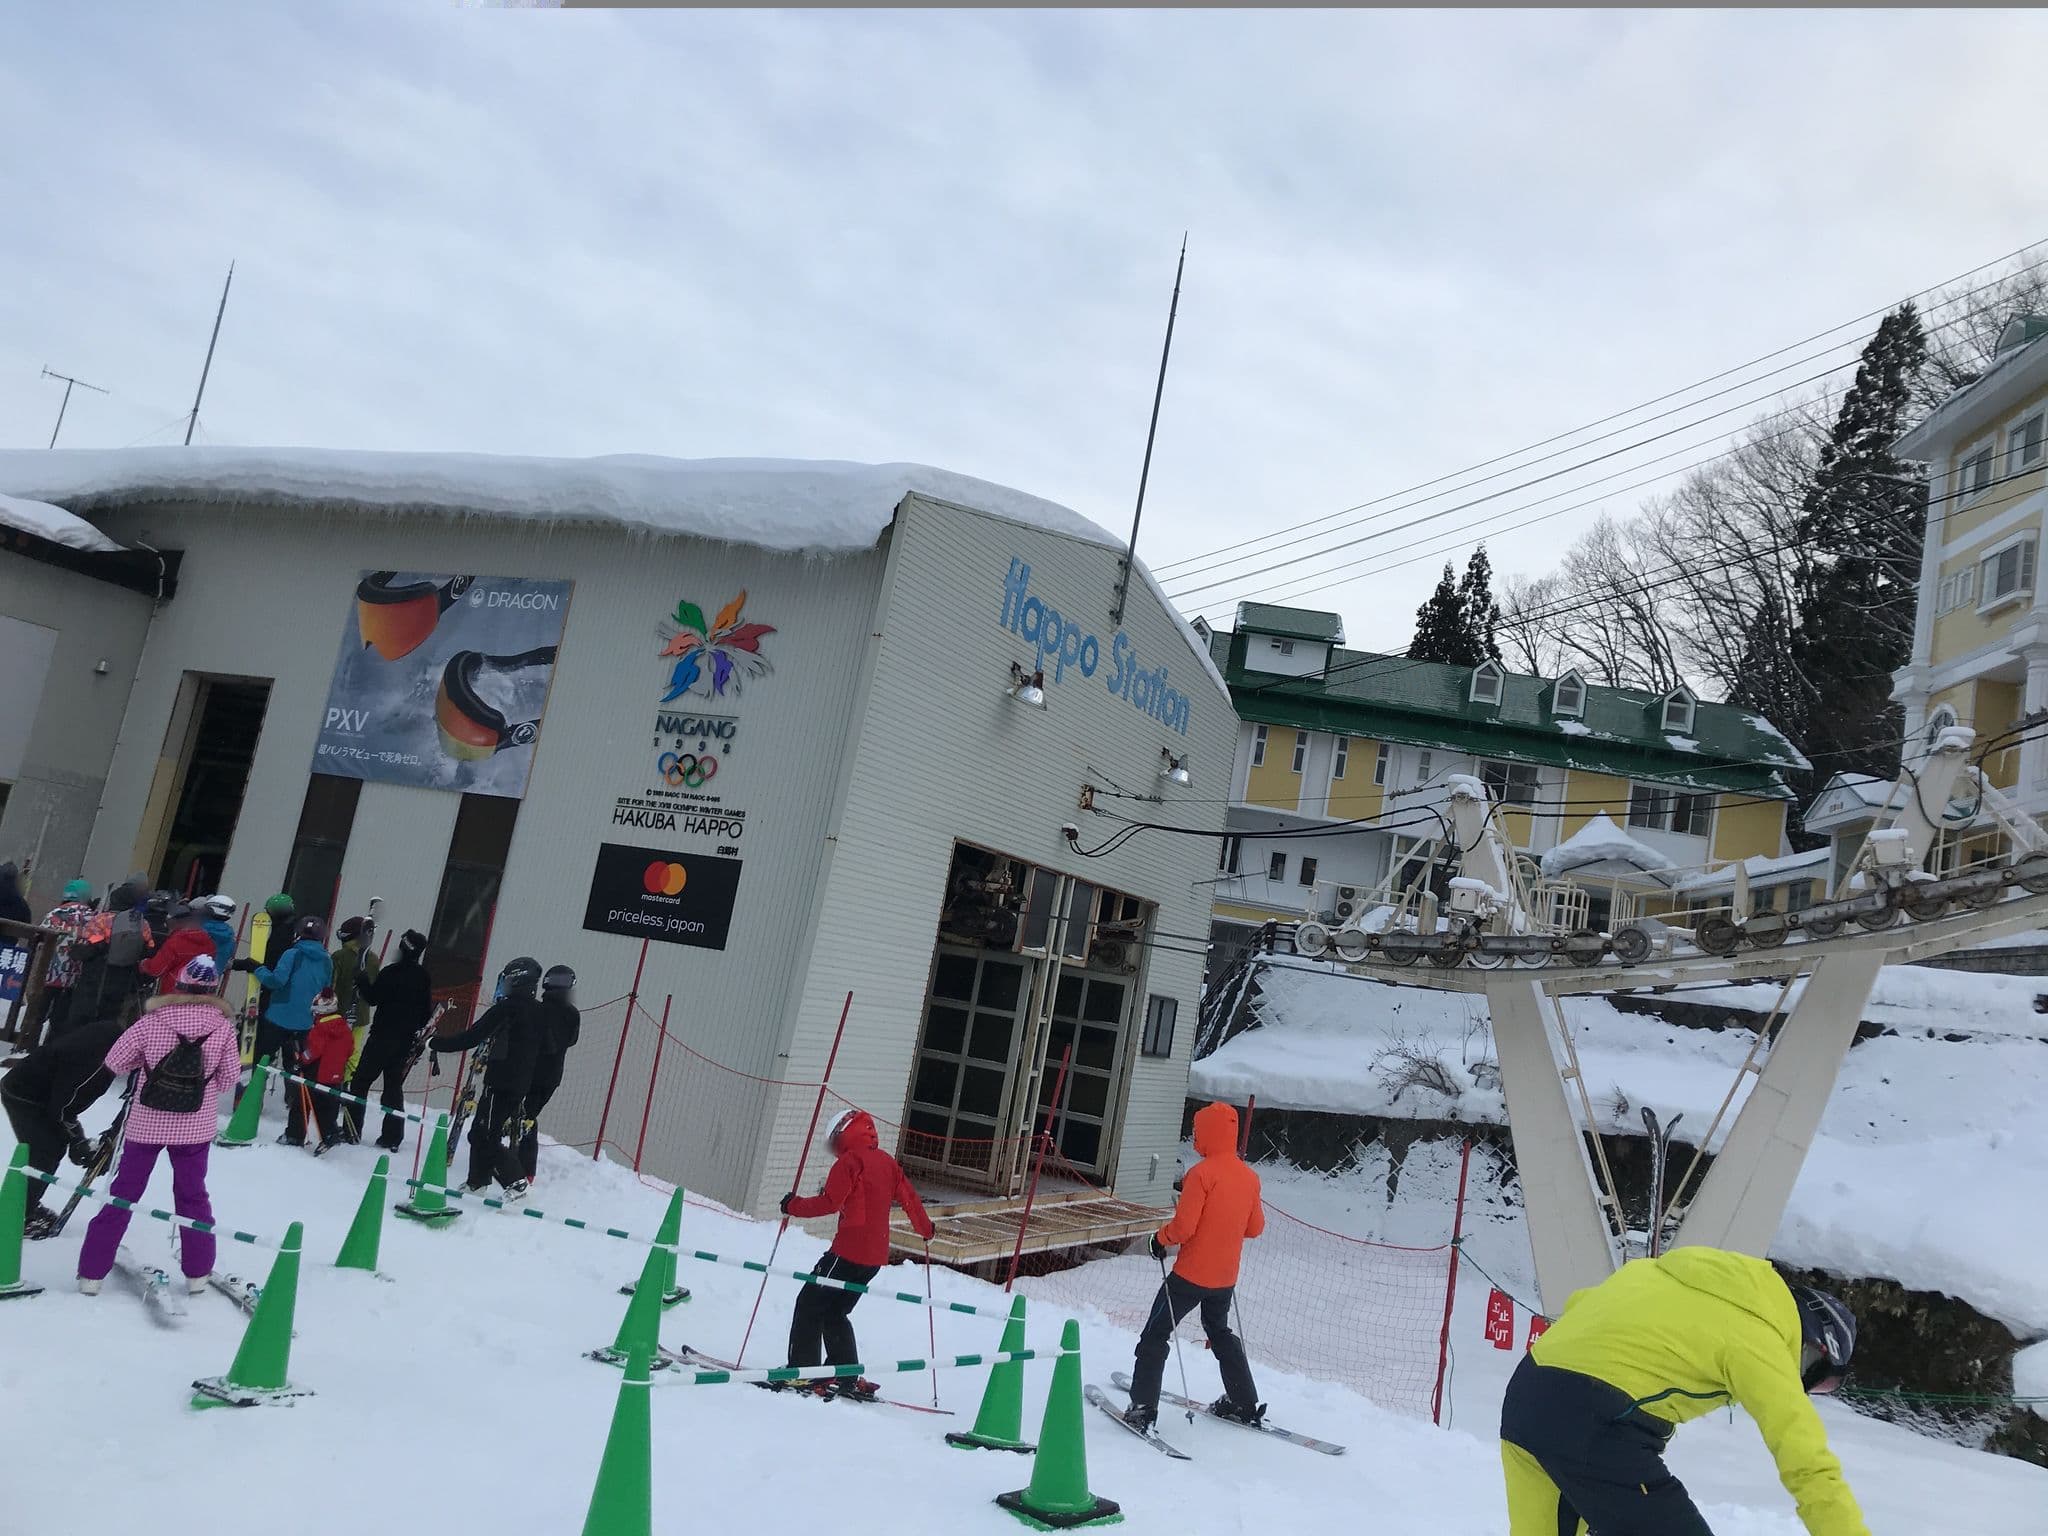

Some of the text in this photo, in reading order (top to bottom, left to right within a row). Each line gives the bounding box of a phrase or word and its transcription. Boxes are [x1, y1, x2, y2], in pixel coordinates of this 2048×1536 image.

[487, 591, 558, 611] DRAGON
[1000, 556, 1190, 736] Happo Station
[325, 707, 370, 732] PXV
[655, 714, 737, 739] NAGANO
[632, 799, 645, 807] FOR
[646, 800, 657, 808] THE
[672, 803, 698, 813] OLYMPIC
[699, 806, 723, 815] WINTER
[724, 809, 745, 817] GAMES
[612, 808, 743, 839] HAKUBA HAPPO
[642, 894, 680, 904] mastercard
